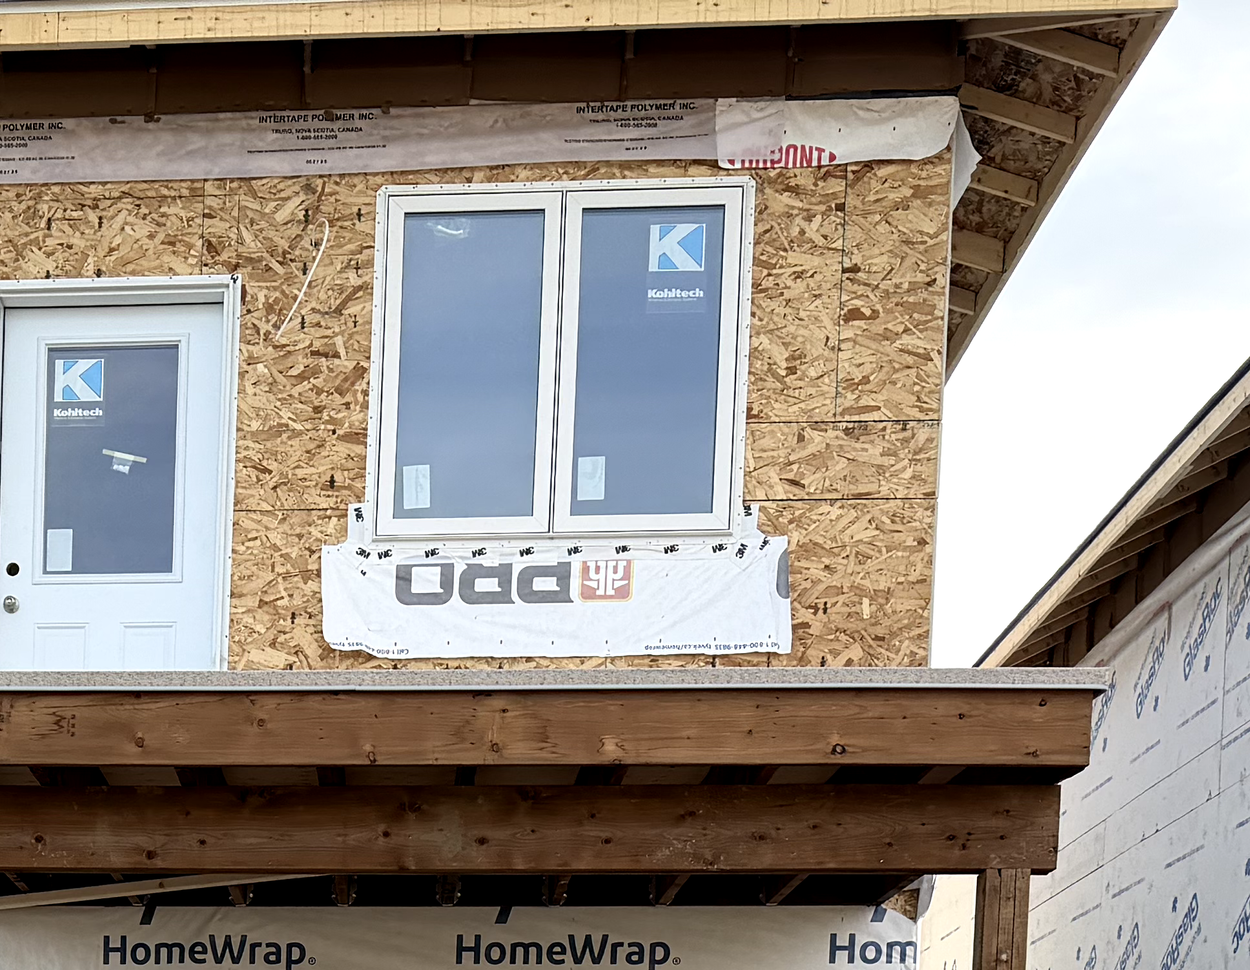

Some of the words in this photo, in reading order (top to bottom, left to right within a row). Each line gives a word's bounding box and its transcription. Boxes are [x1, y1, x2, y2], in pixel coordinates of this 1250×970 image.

[576, 104, 628, 114] INTERTAPE
[630, 101, 676, 112] POLYMER
[258, 114, 309, 124] INTERTAPE
[311, 113, 355, 122] POMER
[2, 122, 45, 131] POLYMER
[647, 287, 704, 299] Kohltech
[53, 407, 103, 417] Kohltech
[377, 548, 393, 560] 3M
[424, 547, 440, 559] 3M
[471, 547, 487, 559] 3M
[519, 546, 535, 558] 3M
[567, 546, 583, 556] 3M
[615, 544, 631, 555] 3M
[663, 544, 680, 555] 3M
[712, 543, 728, 554] 3M
[1183, 577, 1223, 682] GlasRoc
[828, 933, 918, 965] Hom
